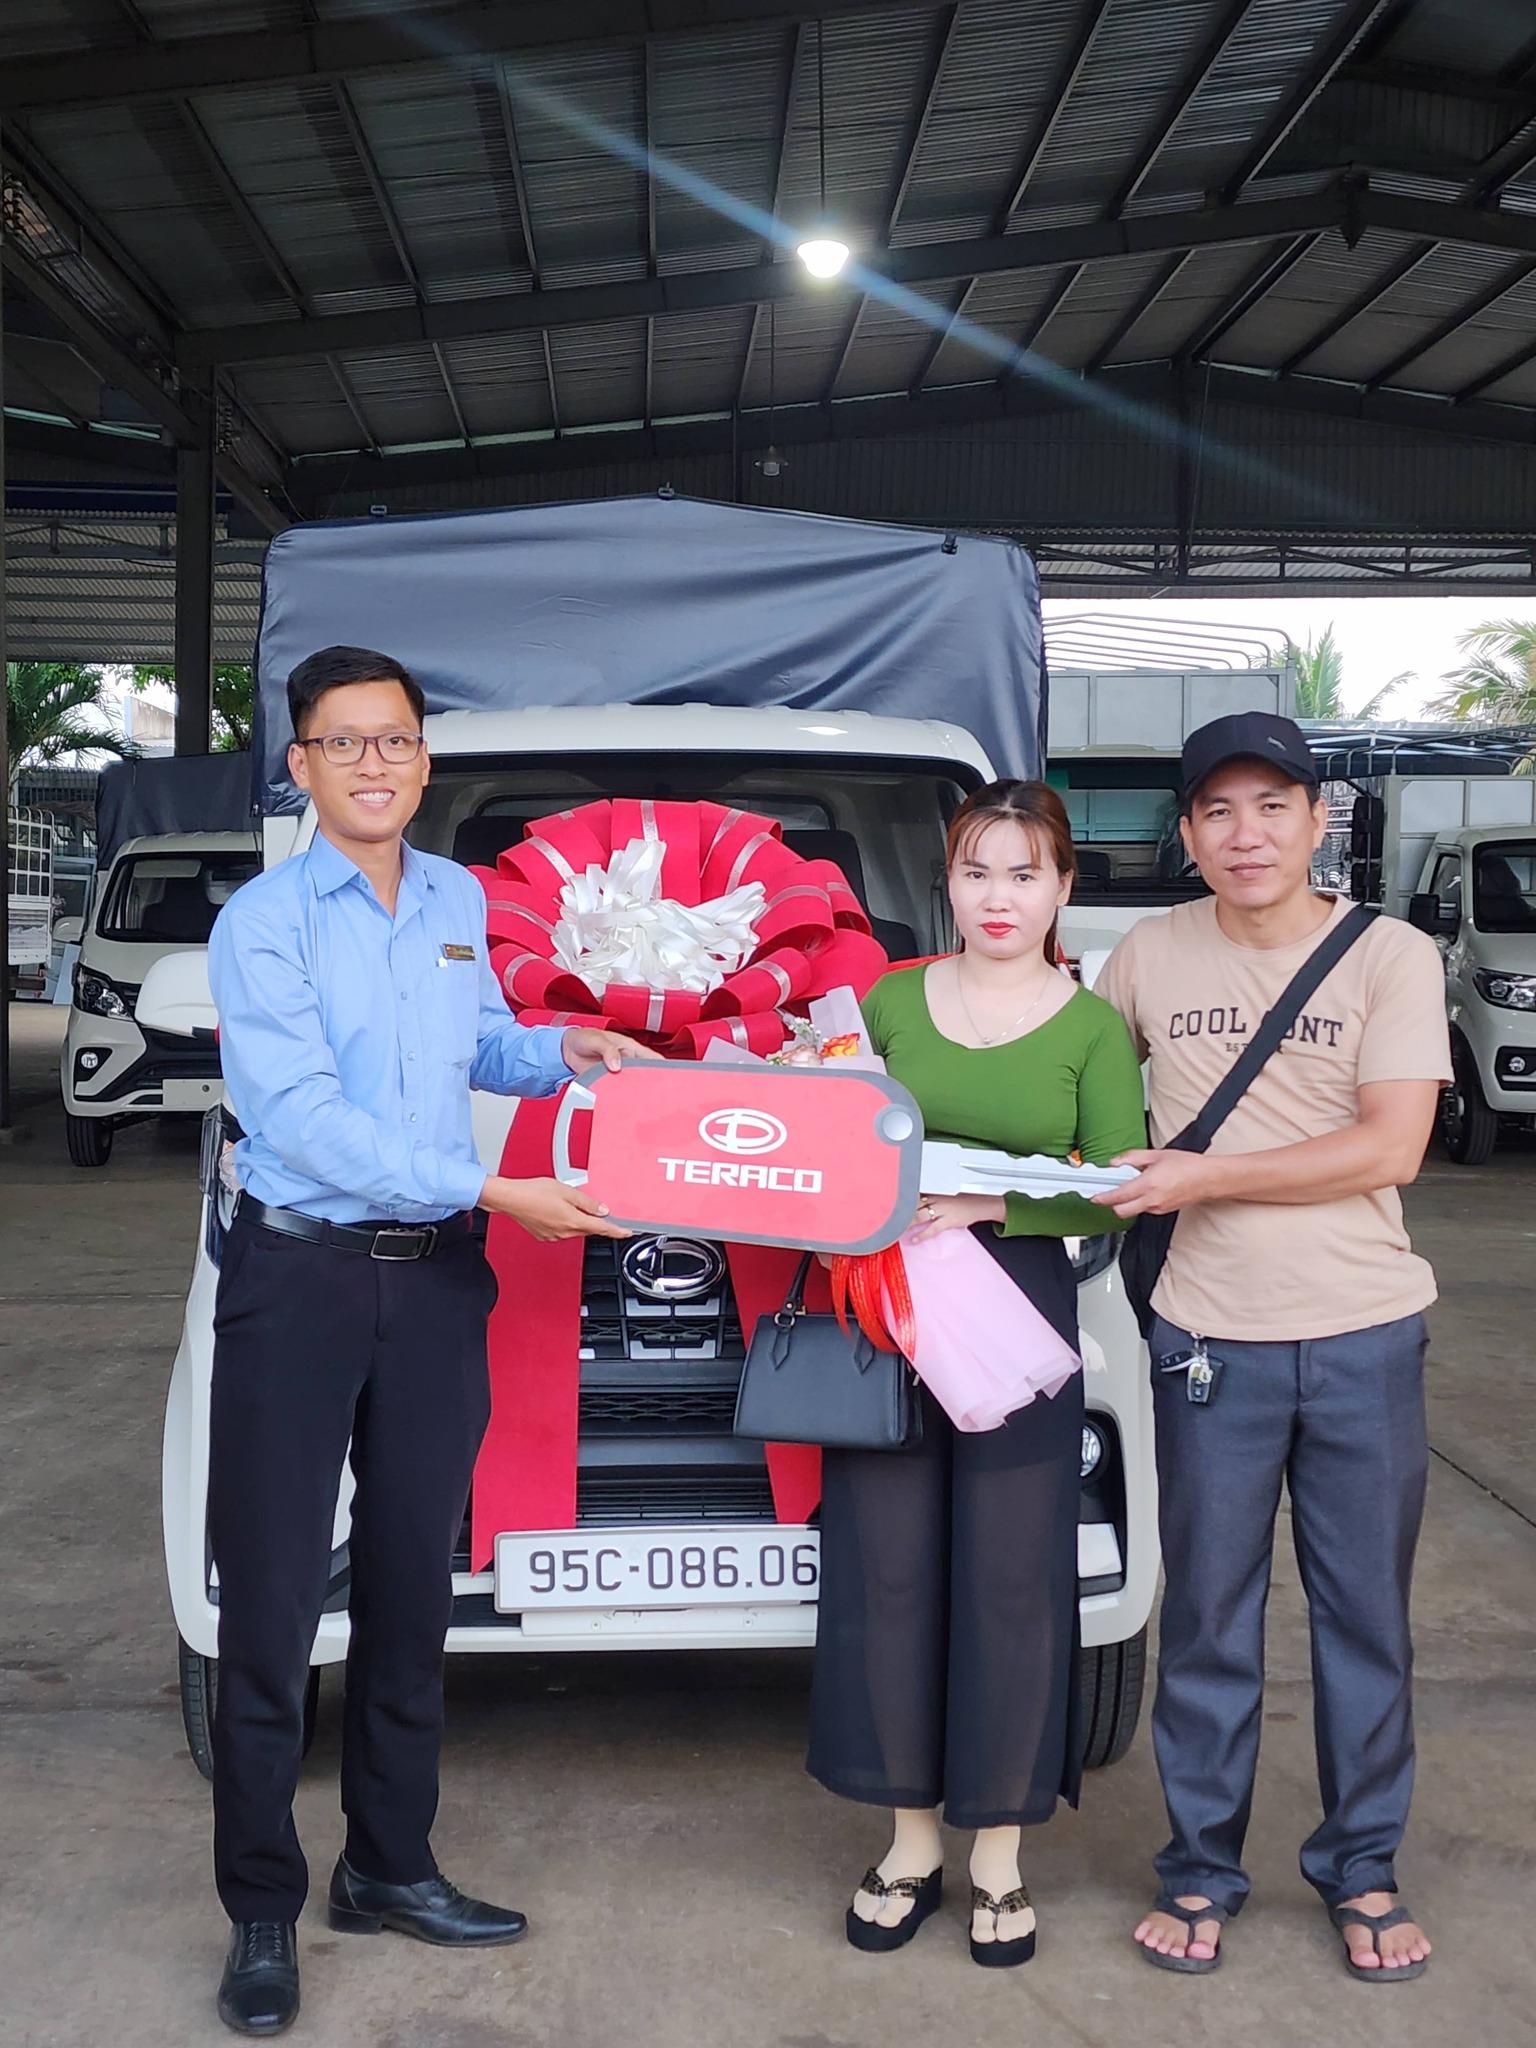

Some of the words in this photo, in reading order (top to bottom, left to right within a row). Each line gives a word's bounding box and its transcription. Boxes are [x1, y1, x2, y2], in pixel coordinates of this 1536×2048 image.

[1169, 1007, 1247, 1039] COOL
[657, 1157, 823, 1194] TERACO
[529, 1544, 818, 1593] 95C-086.06
